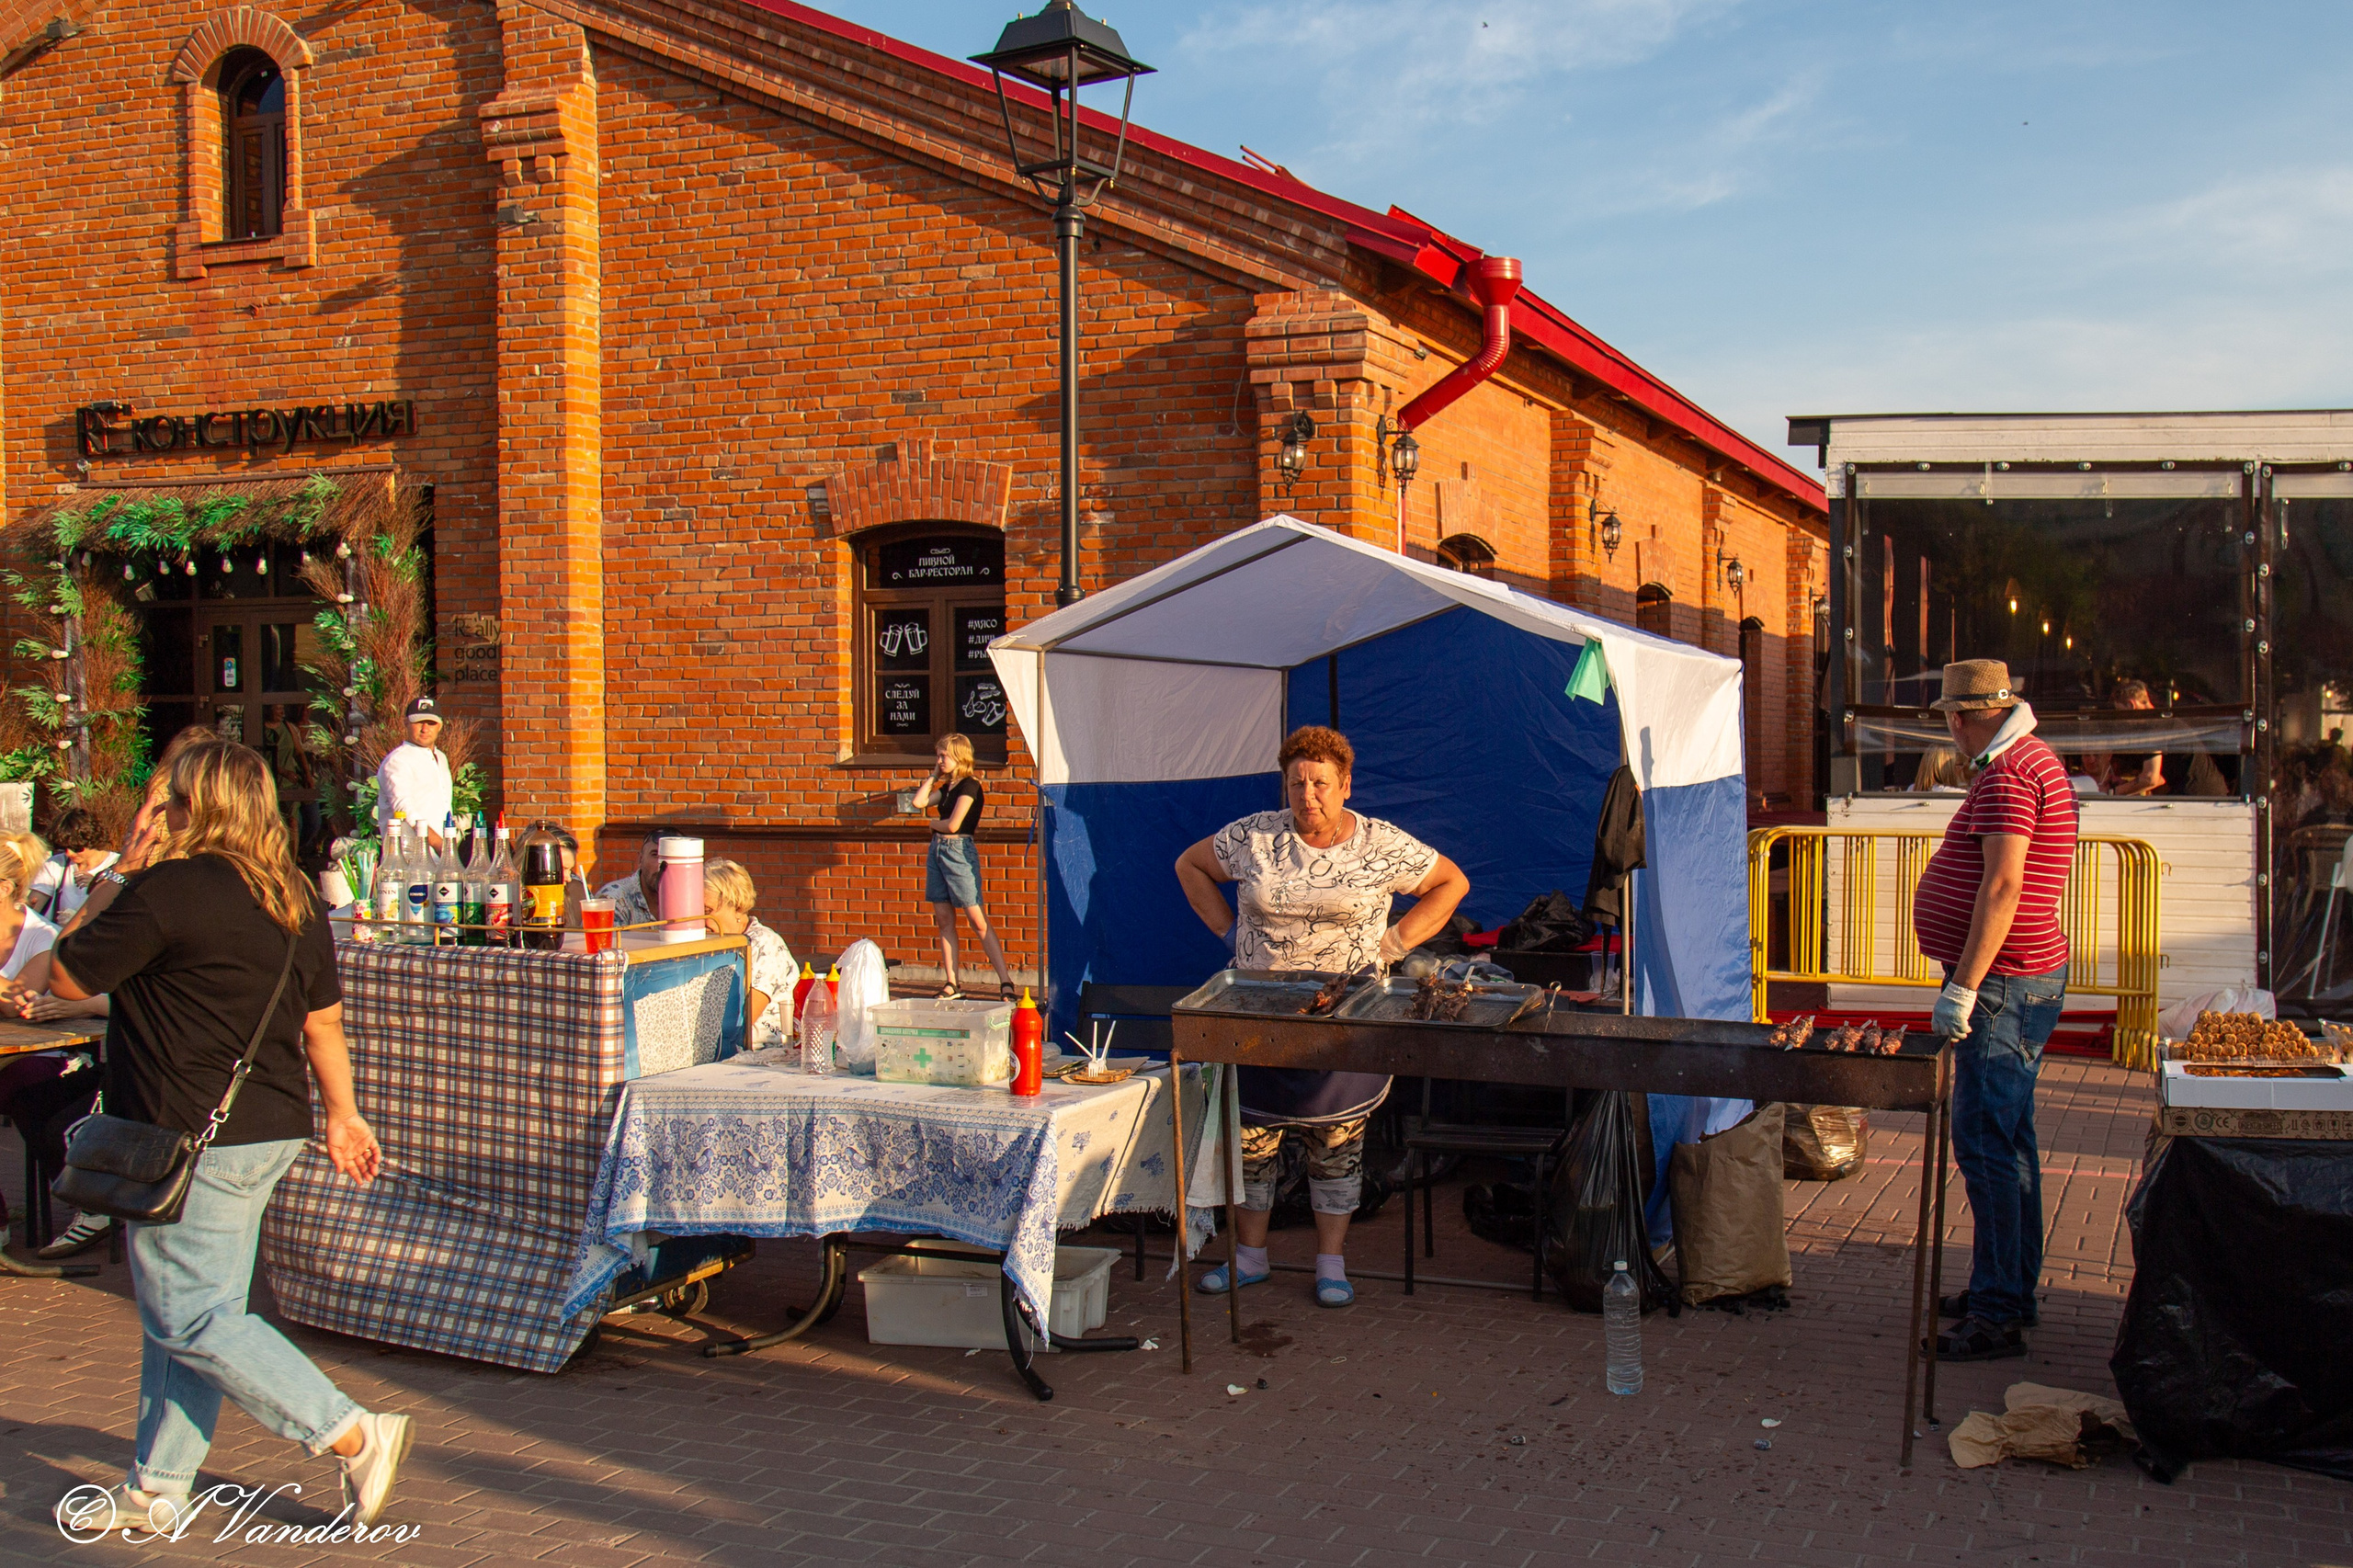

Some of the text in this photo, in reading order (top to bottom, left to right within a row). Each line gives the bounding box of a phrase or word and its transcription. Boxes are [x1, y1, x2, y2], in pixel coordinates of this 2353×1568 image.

[919, 554, 955, 567] ПИВНОЙ
[908, 566, 973, 578] БАР-РЕСТОРАН
[968, 619, 998, 631] #МЯСО
[455, 643, 496, 664] good
[455, 665, 497, 685] place
[885, 688, 920, 699] СЛЕДУЙ
[896, 700, 908, 710] ЗА
[890, 711, 915, 722] НАМИ
